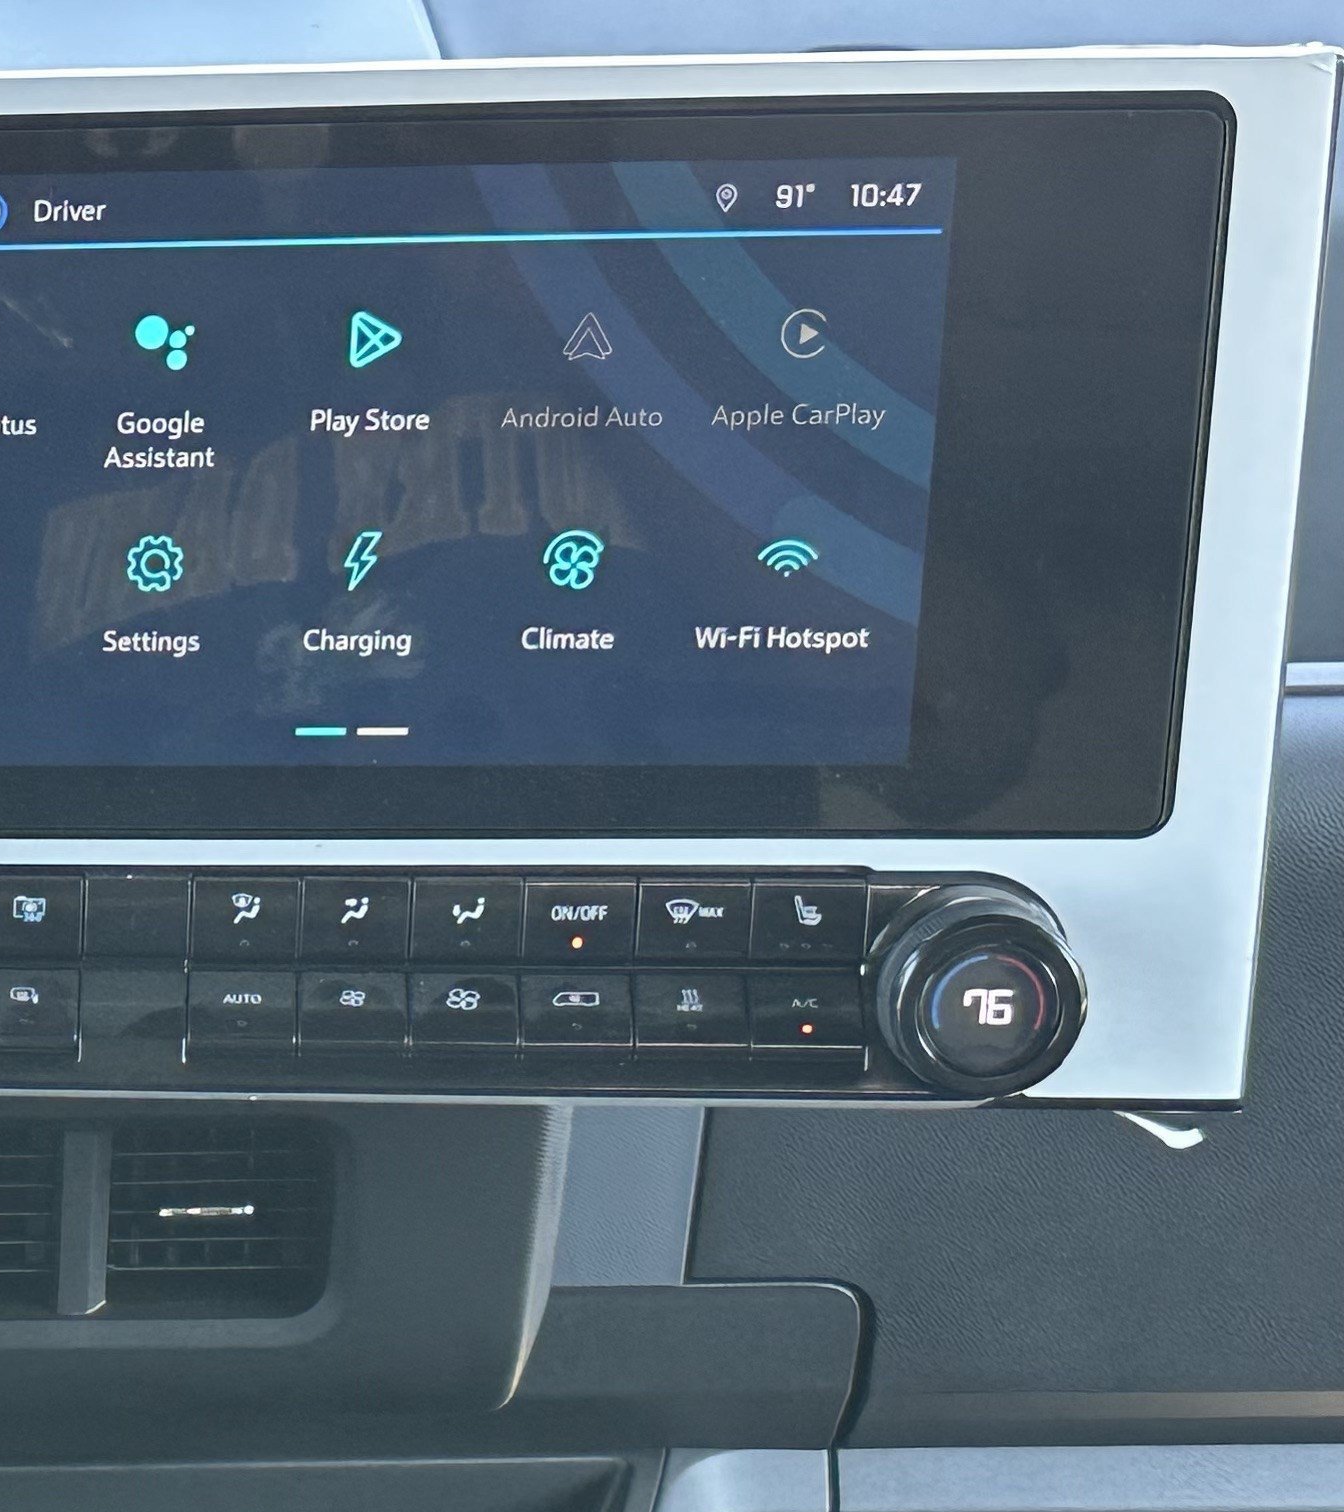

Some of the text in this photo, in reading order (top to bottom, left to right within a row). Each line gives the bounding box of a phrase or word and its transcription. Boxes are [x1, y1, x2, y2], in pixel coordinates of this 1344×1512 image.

[851, 182, 922, 208] 10:47
[33, 199, 107, 223] Driver
[117, 409, 205, 440] Google
[310, 408, 430, 438] Play Store
[500, 405, 663, 428] Android Auto
[710, 402, 886, 432] Apple CarPlay
[103, 446, 215, 469] Assistant
[102, 630, 201, 658] Settings
[303, 628, 412, 657] Charging
[521, 626, 615, 650] Climate
[695, 625, 870, 655] Wi-Fi Hotspot
[551, 905, 608, 922] ON/OFF
[222, 993, 262, 1005] AUTO
[962, 988, 1015, 1026] 76
